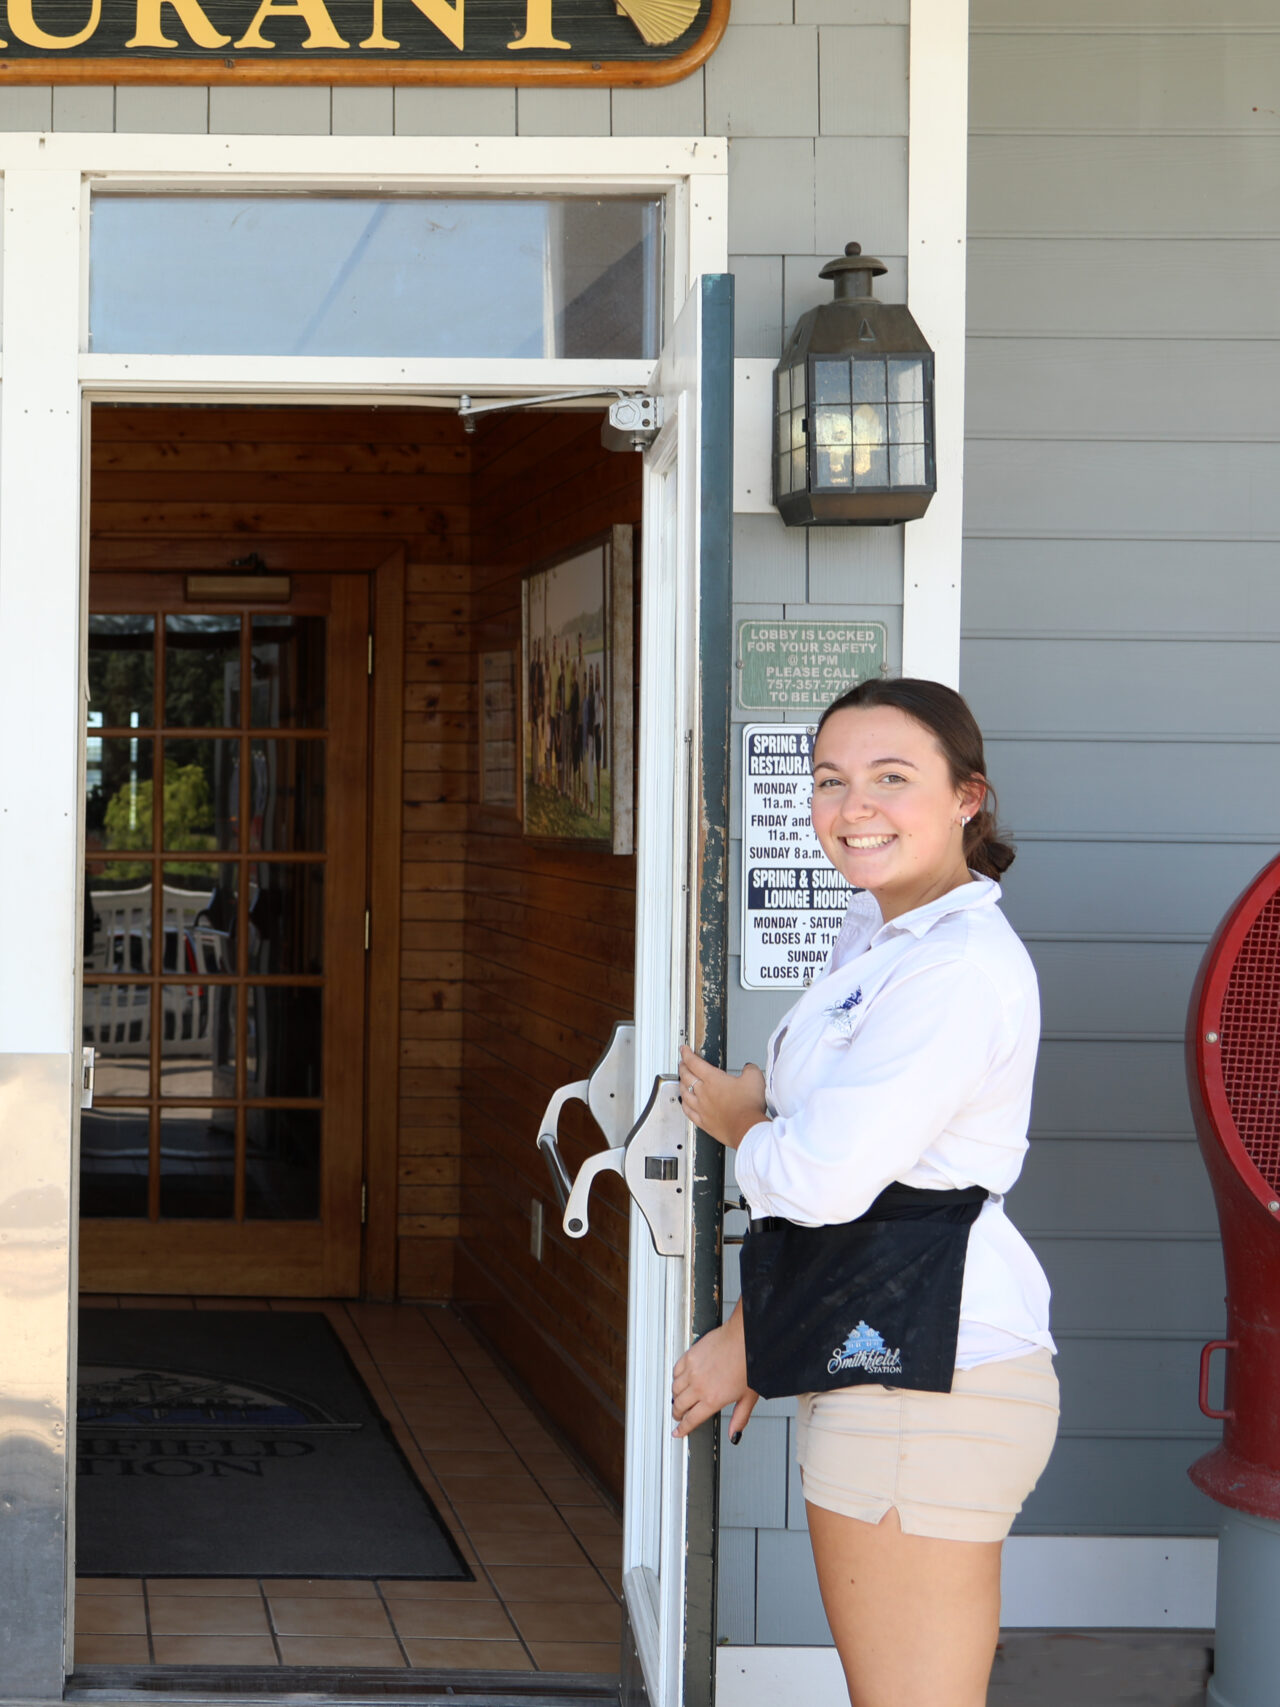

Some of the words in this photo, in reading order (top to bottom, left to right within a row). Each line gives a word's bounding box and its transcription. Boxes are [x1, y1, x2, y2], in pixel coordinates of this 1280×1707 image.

[751, 629, 798, 640] LOBBY
[801, 630, 815, 641] IS
[818, 630, 874, 641] LOCKED
[747, 641, 776, 653] FOR
[780, 641, 820, 653] YOUR
[823, 642, 877, 654] SAFETY
[787, 654, 798, 666] @
[801, 654, 838, 665] 11PM
[766, 666, 820, 678] PLEASE
[823, 667, 859, 678] CALL
[770, 691, 788, 702] TO
[791, 691, 810, 702] BE
[812, 692, 837, 702] LET
[753, 735, 797, 754] SPRING
[800, 735, 810, 754] &
[753, 782, 798, 795] MONDAY
[751, 814, 788, 827] FRIDAY
[792, 815, 811, 827] and
[749, 847, 790, 859] SUNDAY
[752, 869, 796, 889] SPRING
[799, 869, 809, 889] &
[812, 869, 856, 889] SUMM
[764, 889, 810, 909] LOUNGE
[753, 916, 798, 929] MONDAY
[761, 932, 801, 945] CLOSES
[804, 932, 817, 945] AT
[787, 950, 829, 963] SUNDAY
[760, 966, 799, 979] CLOSES
[803, 966, 815, 979] AT
[827, 1348, 902, 1375] Smithfield
[868, 1366, 903, 1374] STATION
